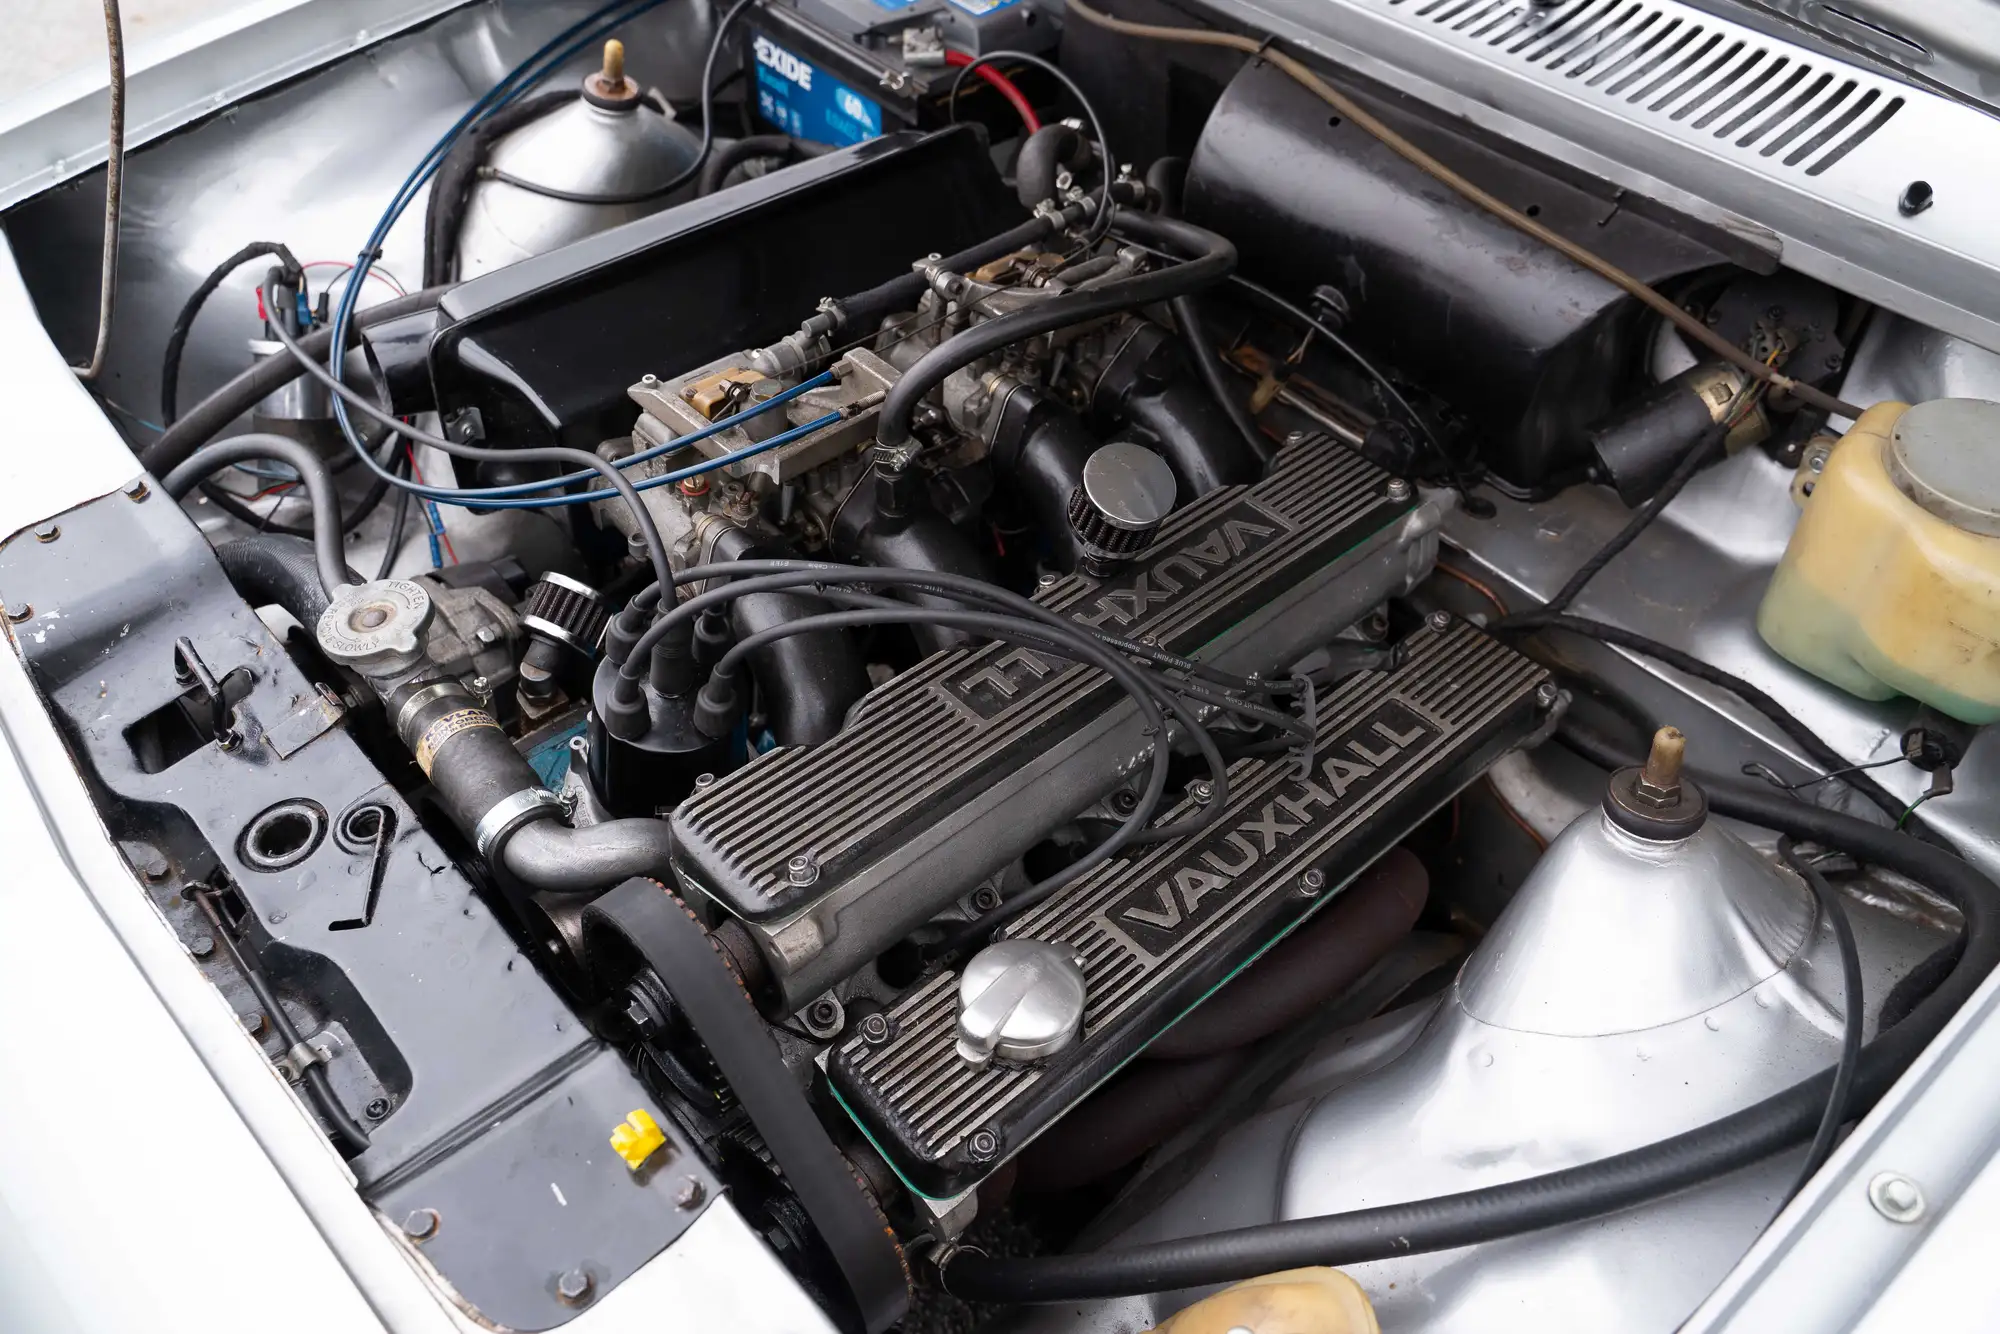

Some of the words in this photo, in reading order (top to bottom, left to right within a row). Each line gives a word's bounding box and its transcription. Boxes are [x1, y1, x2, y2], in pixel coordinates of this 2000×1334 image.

[753, 35, 813, 92] EXIDE
[388, 580, 425, 609] TIGHTEN
[1152, 651, 1174, 664] PRINT
[1120, 720, 1427, 932] VAUXHALL
